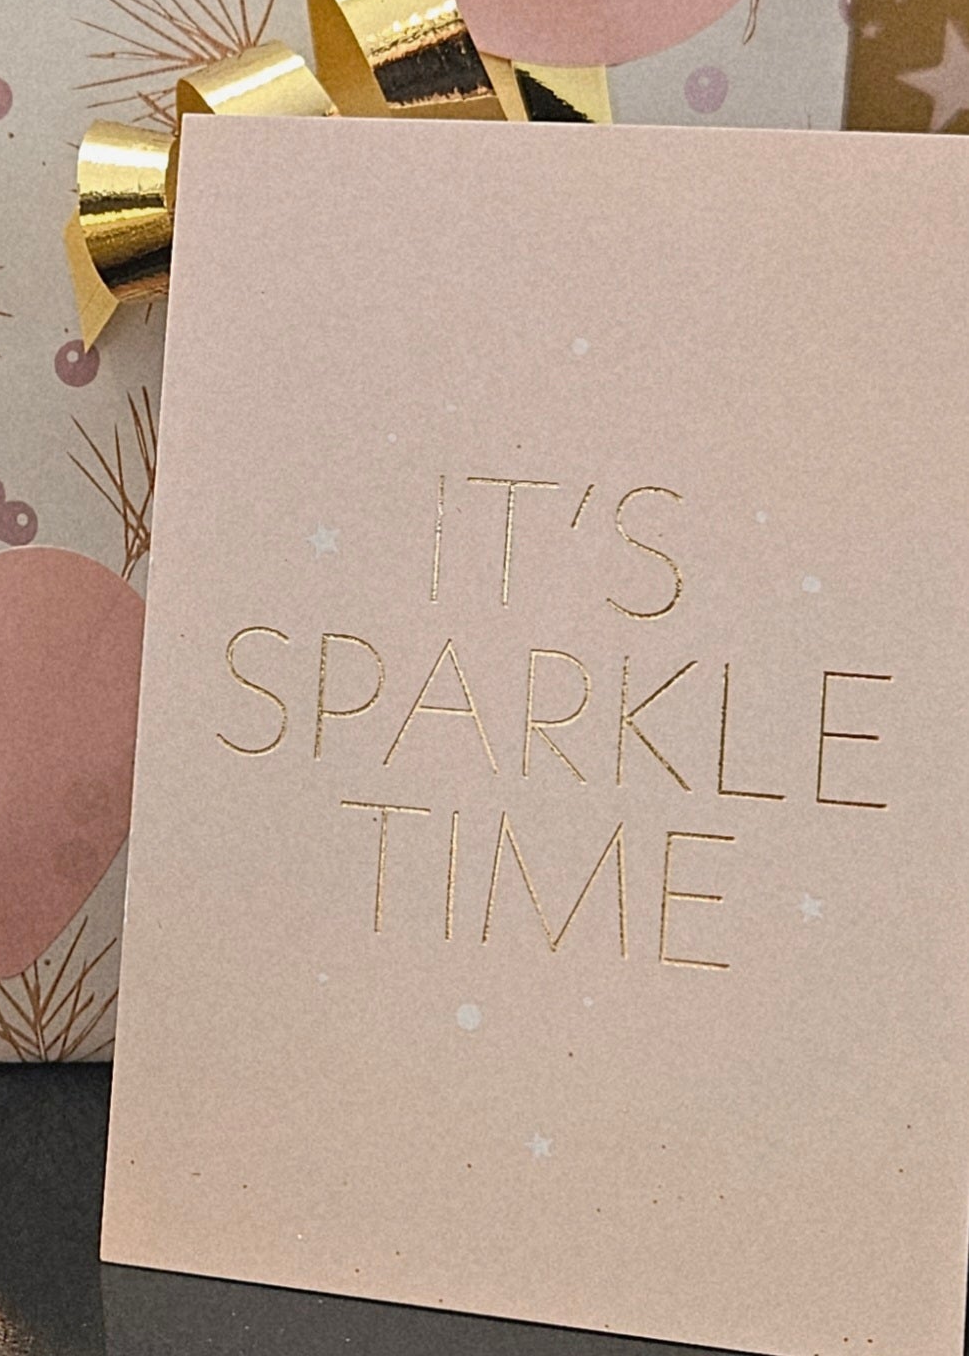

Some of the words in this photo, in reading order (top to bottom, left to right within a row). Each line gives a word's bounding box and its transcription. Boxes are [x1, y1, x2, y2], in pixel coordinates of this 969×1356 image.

[430, 475, 685, 620] IT'S
[216, 625, 893, 810] SPARKLE
[340, 800, 736, 971] TIME
